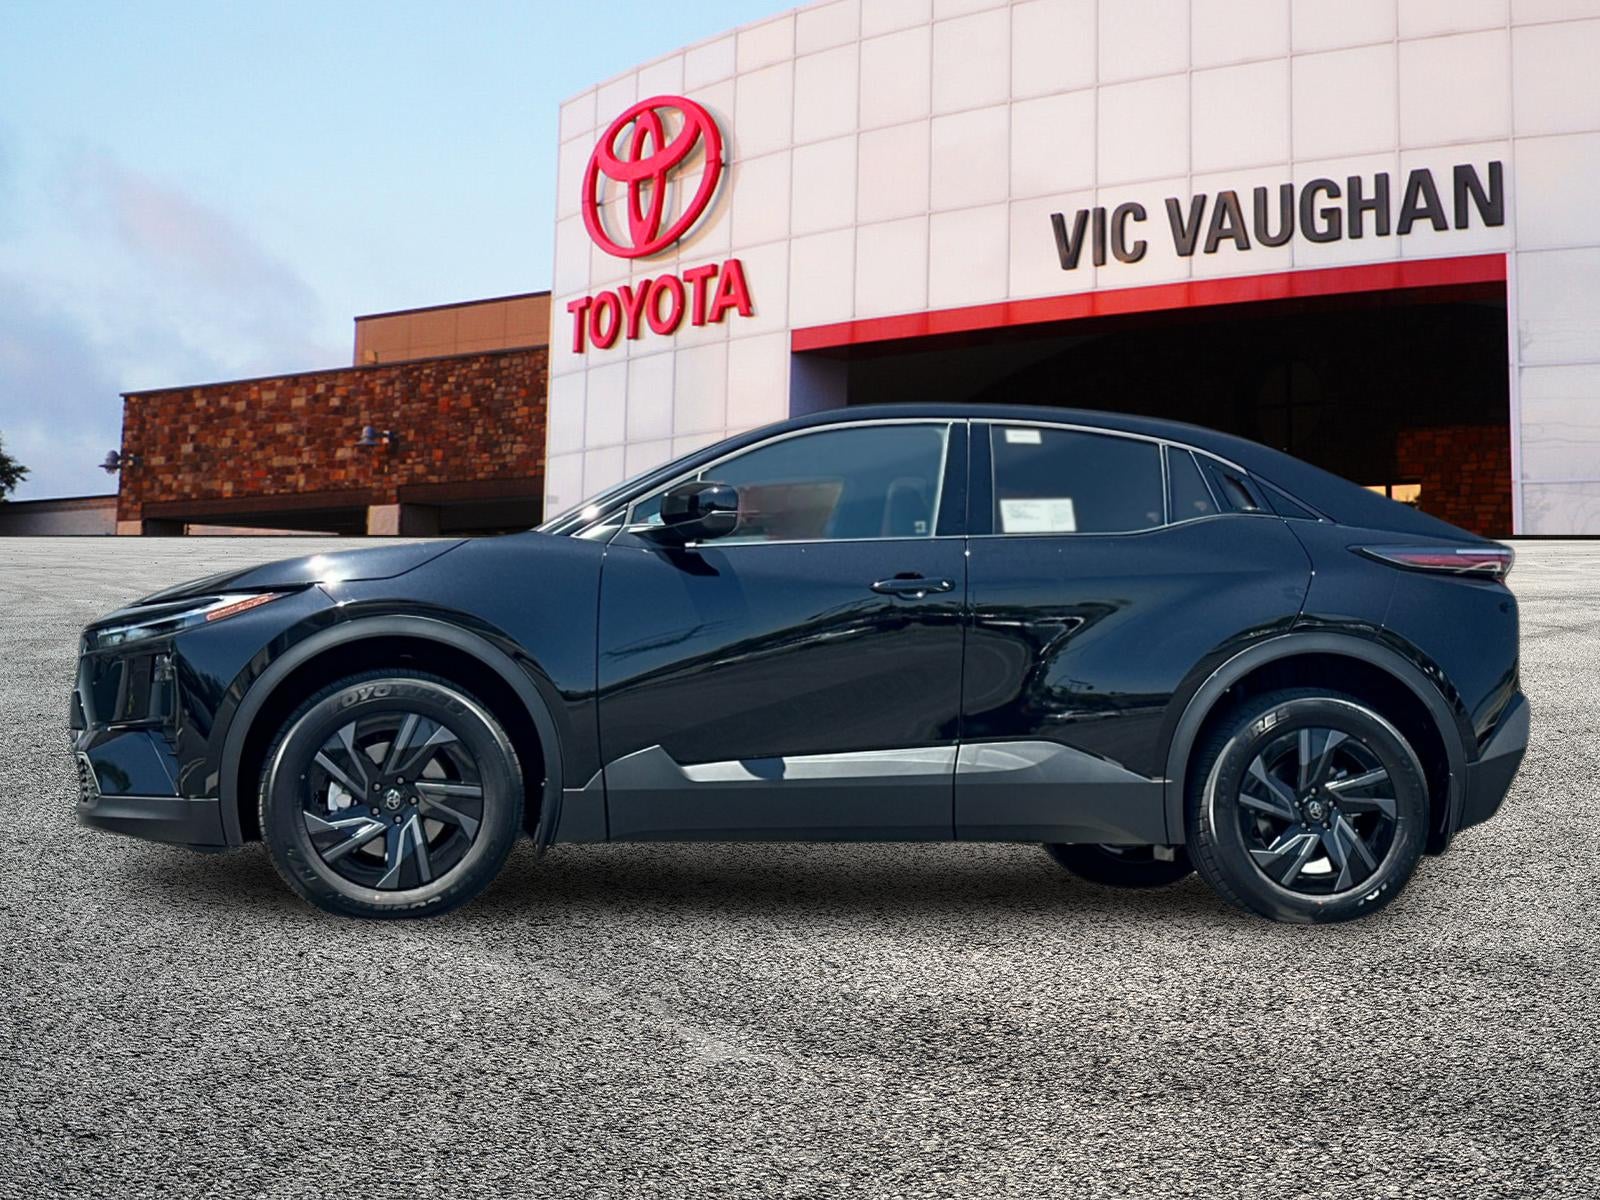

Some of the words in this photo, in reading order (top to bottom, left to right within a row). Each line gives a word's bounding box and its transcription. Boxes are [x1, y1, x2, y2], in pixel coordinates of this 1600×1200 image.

[1051, 202, 1148, 271] VIC
[1165, 161, 1505, 258] VAUGHAN
[567, 258, 754, 353] TOYOTA
[329, 684, 393, 711] OYO
